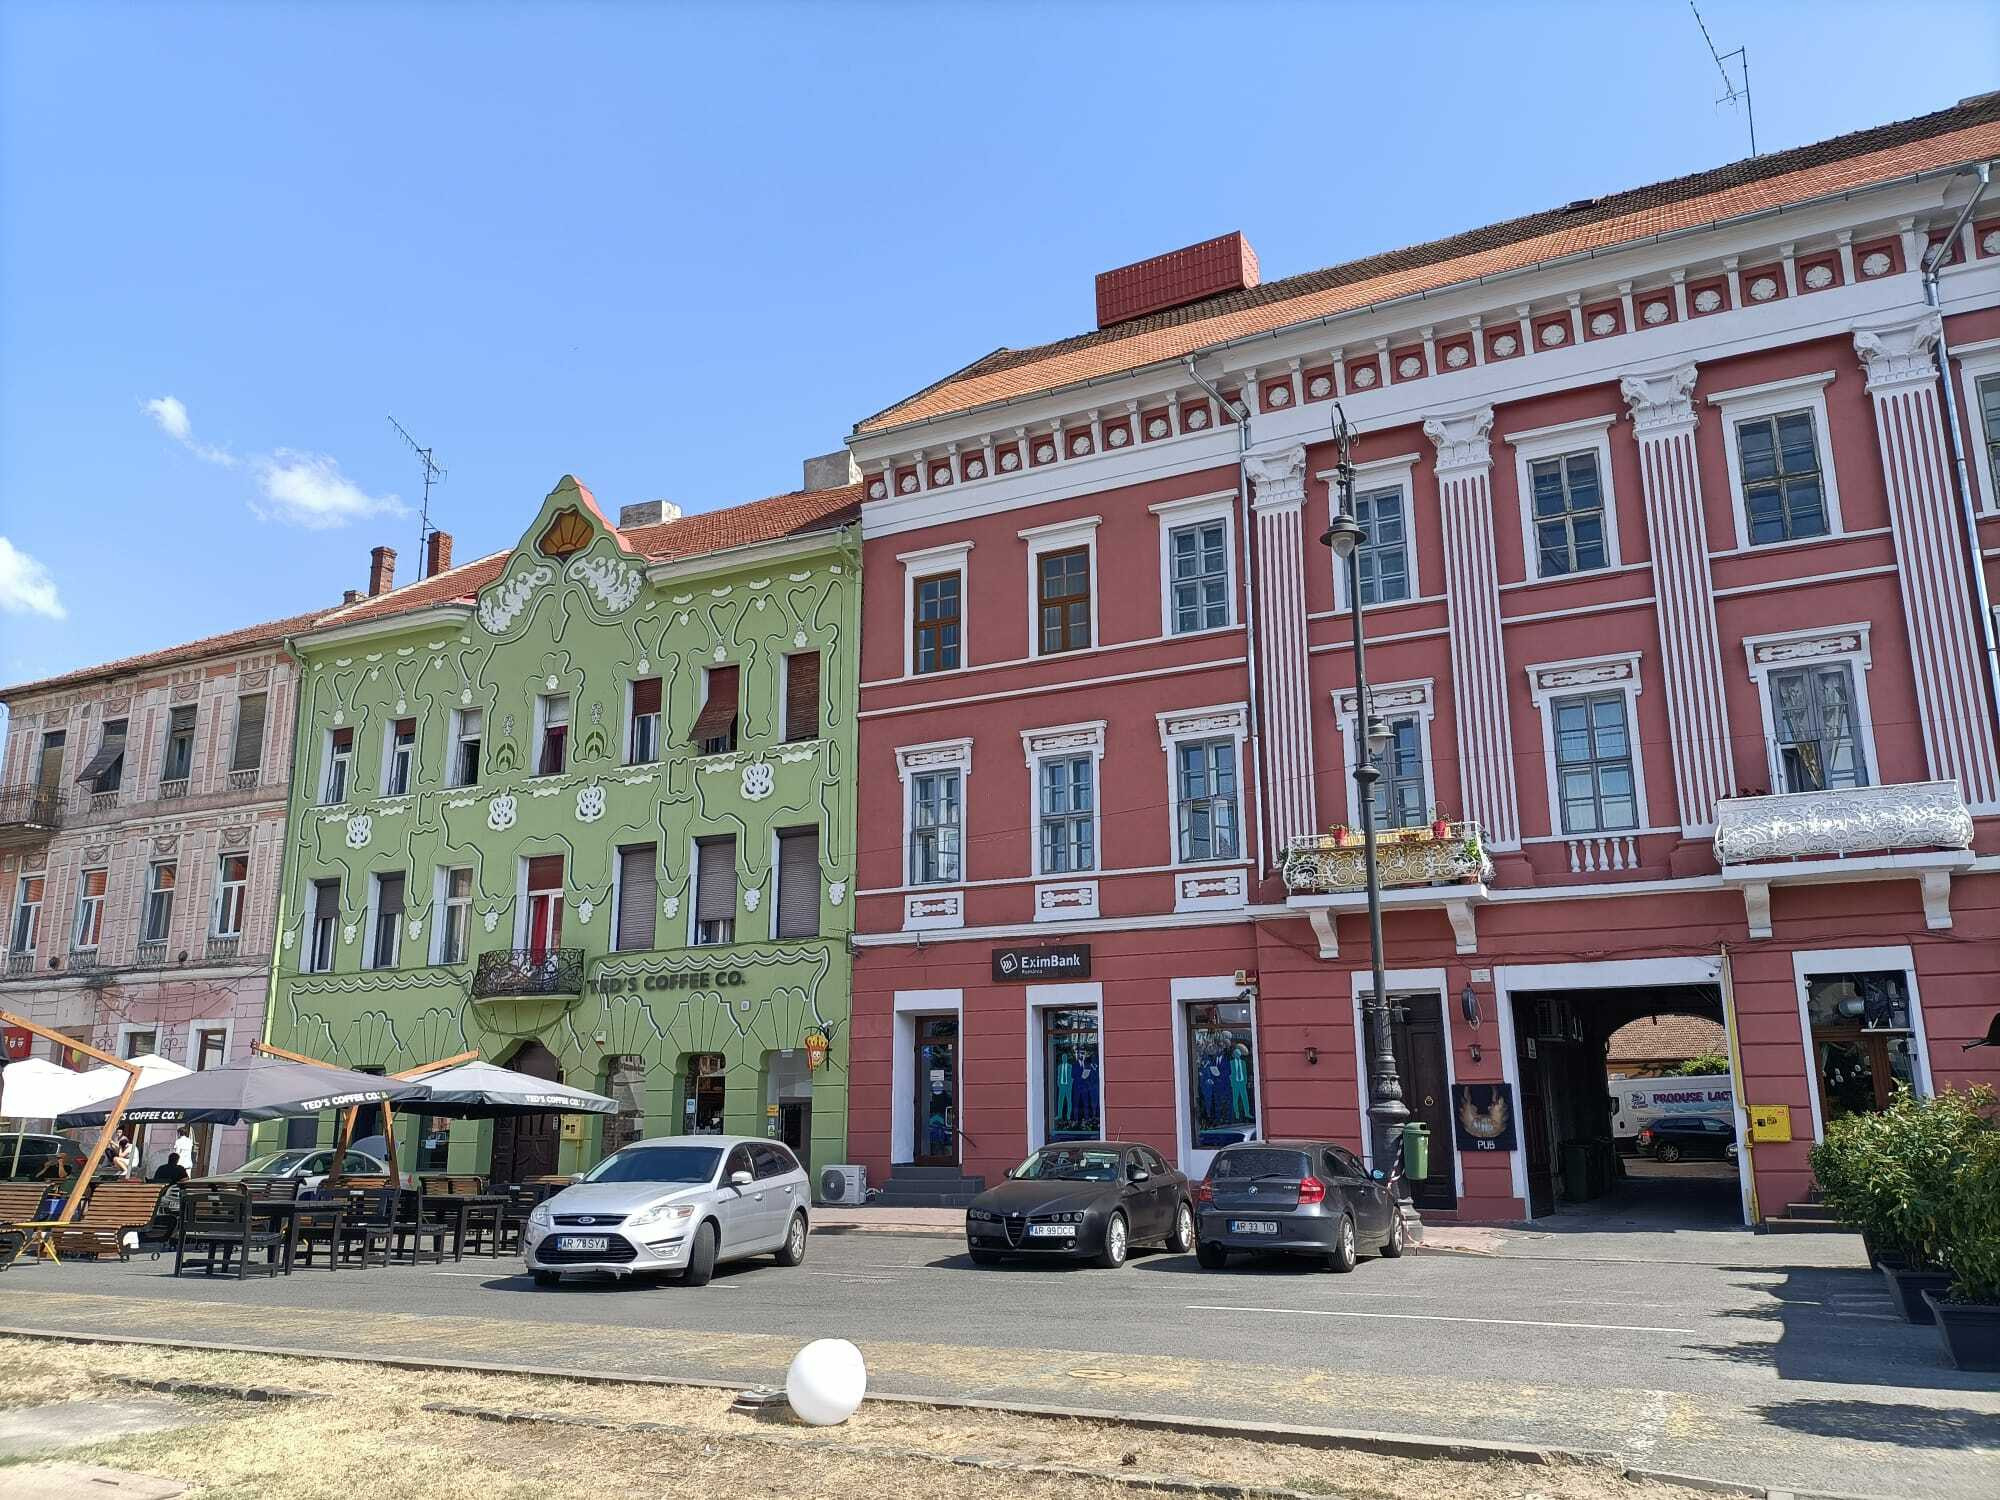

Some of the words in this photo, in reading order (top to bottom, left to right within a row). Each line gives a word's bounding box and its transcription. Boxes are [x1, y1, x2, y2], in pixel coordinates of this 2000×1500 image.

[1021, 953, 1081, 968] EximBank
[587, 976, 637, 994] TED'S
[643, 972, 710, 991] COFFEE
[715, 970, 746, 987] CO.
[301, 1098, 330, 1111] TED'S
[331, 1092, 364, 1105] COFFEE
[546, 1095, 569, 1105] COFFEE
[1652, 1091, 1705, 1104] PRODUSE
[129, 1111, 161, 1120] COFFEE
[1477, 1140, 1496, 1150] PUB
[1034, 1226, 1044, 1235] AR
[1236, 1222, 1246, 1231] AR
[1248, 1222, 1258, 1231] 33
[562, 1238, 573, 1249] AR
